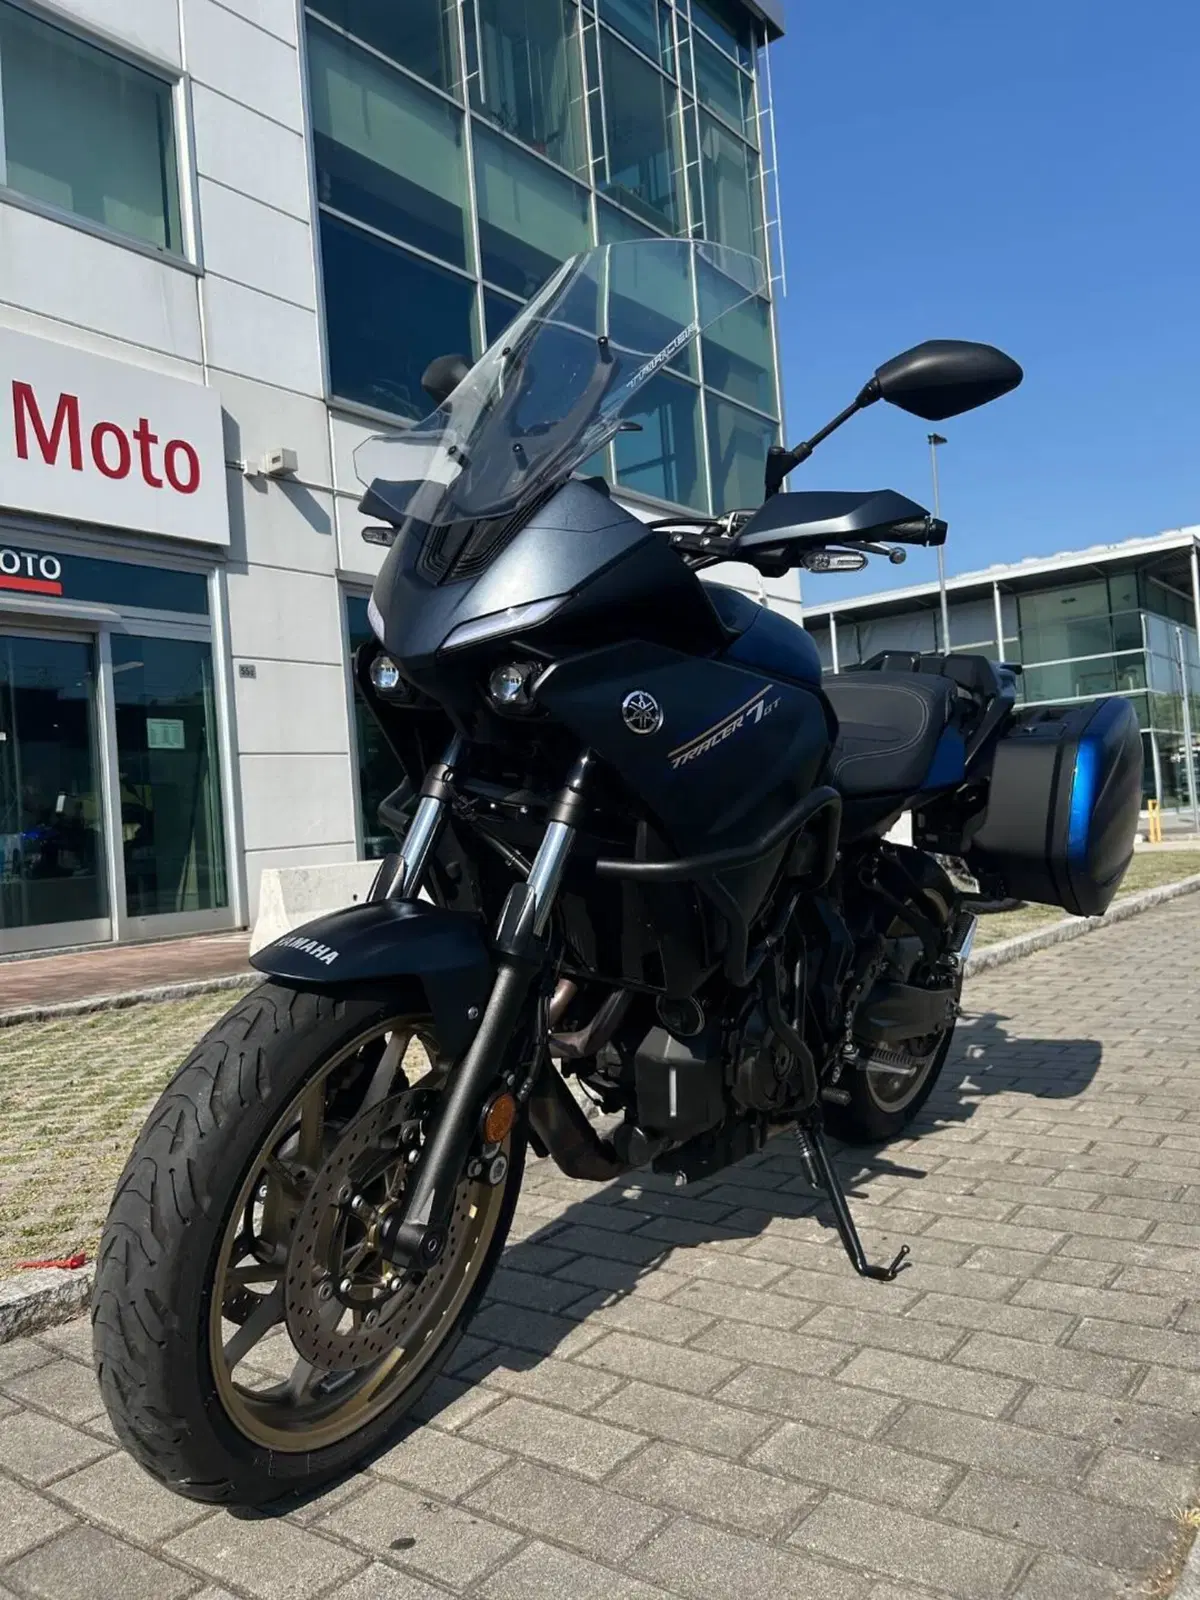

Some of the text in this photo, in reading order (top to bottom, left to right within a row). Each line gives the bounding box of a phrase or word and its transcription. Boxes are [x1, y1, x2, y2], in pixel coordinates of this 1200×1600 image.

[12, 380, 200, 494] Moto
[0, 549, 61, 580] OTO
[671, 715, 743, 769] TRACER
